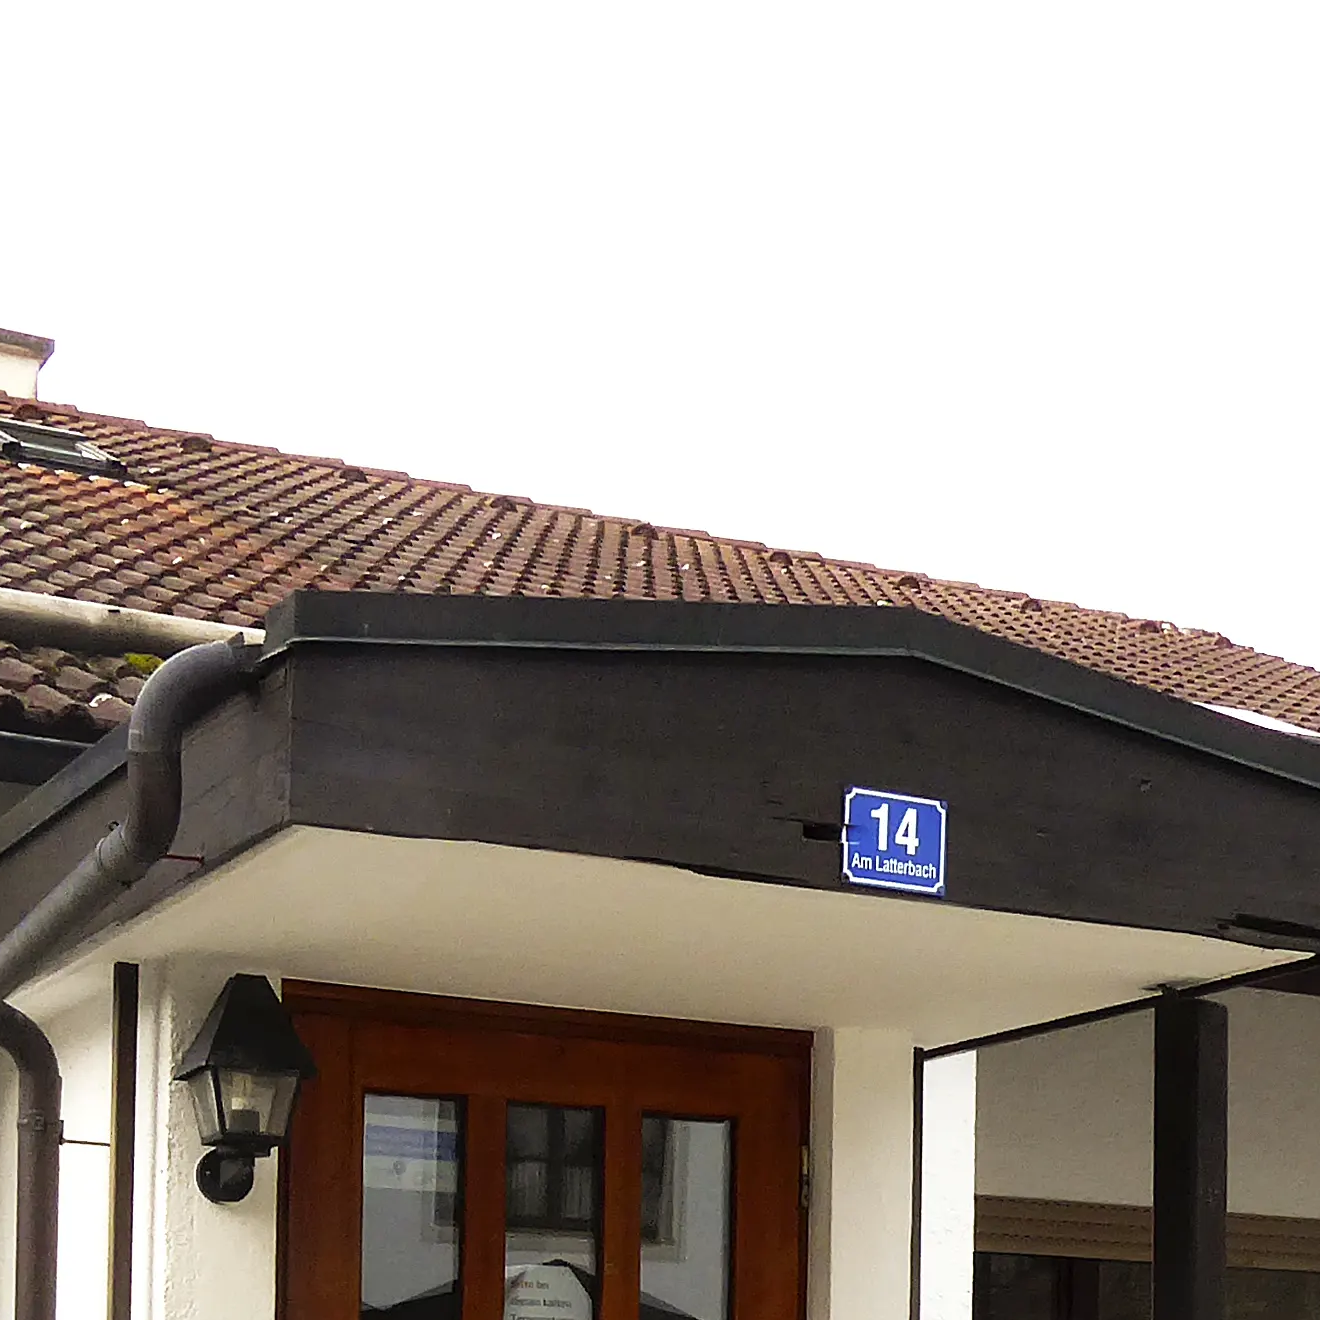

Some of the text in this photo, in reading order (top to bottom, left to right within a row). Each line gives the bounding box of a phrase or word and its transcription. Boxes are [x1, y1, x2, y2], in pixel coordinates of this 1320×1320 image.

[870, 803, 920, 856] 14
[851, 852, 937, 880] Am Latterbach
